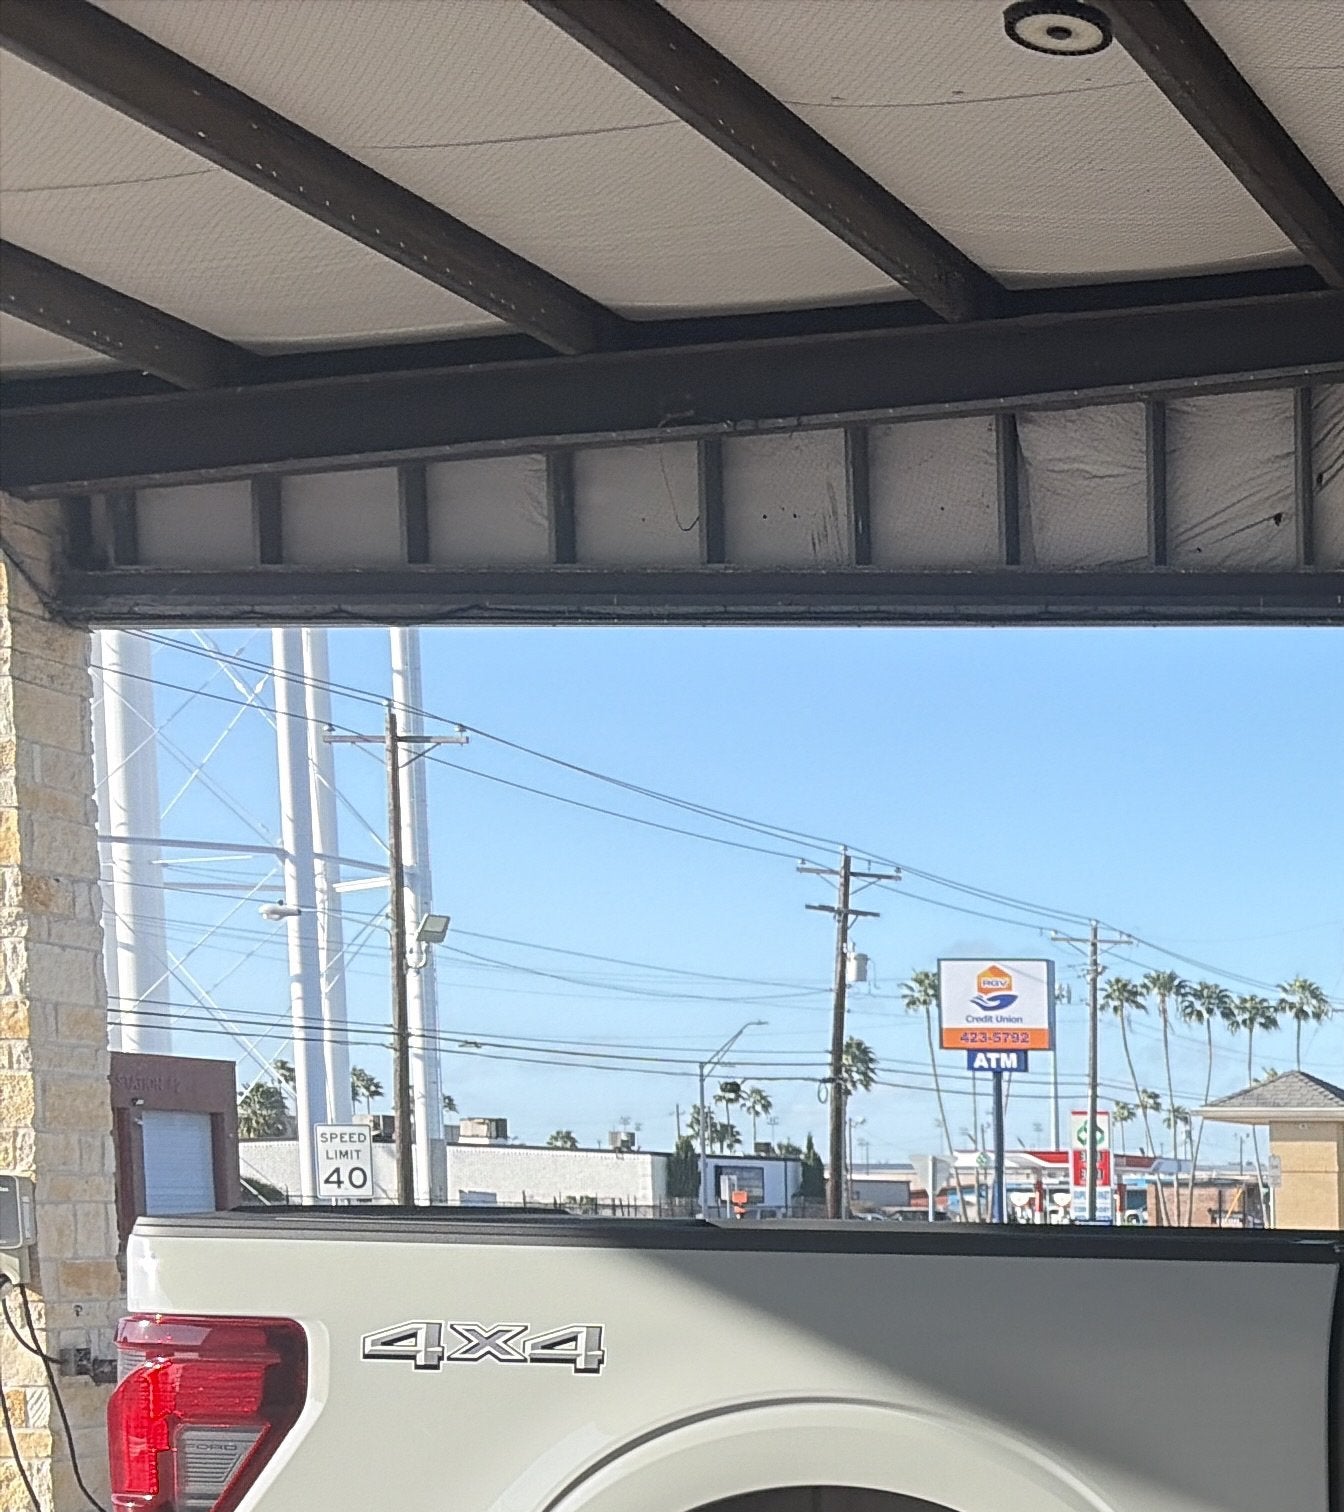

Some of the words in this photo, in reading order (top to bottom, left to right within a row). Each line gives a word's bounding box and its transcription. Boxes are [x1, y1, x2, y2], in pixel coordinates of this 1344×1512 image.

[965, 1015, 993, 1023] Credit
[996, 1015, 1023, 1023] Union
[960, 1031, 1030, 1043] 423-5792
[973, 1052, 1018, 1069] ATM
[320, 1132, 367, 1143] SPEED
[326, 1149, 362, 1160] LIMIT
[323, 1166, 368, 1189] 40
[183, 1443, 237, 1451] FORD
